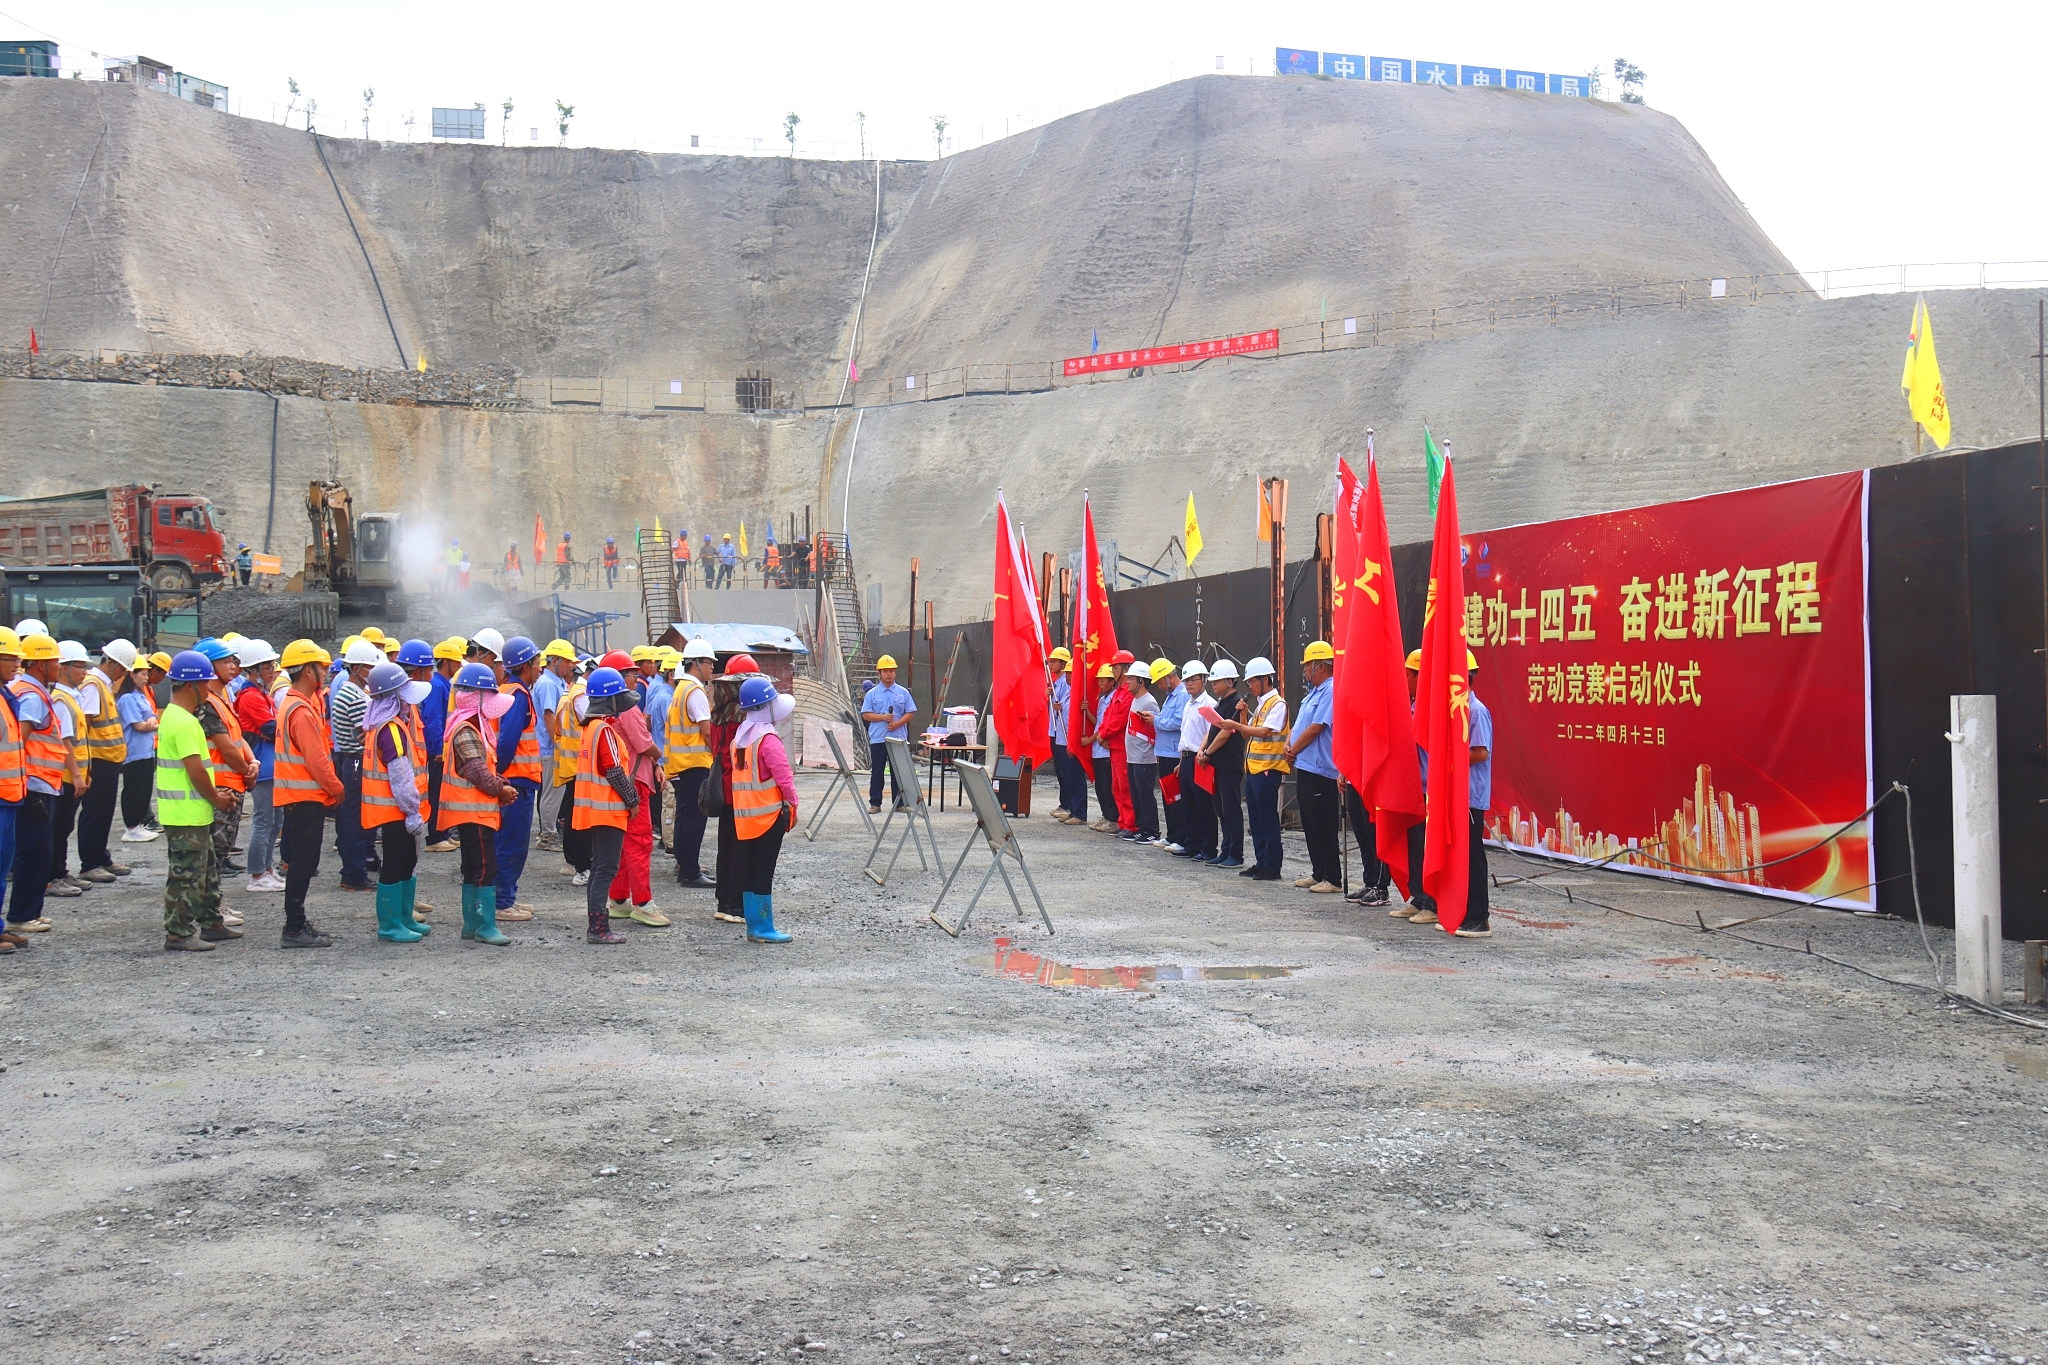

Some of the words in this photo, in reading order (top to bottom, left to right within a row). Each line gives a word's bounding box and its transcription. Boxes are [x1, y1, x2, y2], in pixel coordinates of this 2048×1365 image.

[1334, 57, 1579, 96] 中国水电四局
[1464, 584, 1597, 647] 建功十四五
[1619, 560, 1823, 643] 奋进新征程
[1528, 660, 1702, 707] 劳动竞赛启动仪式
